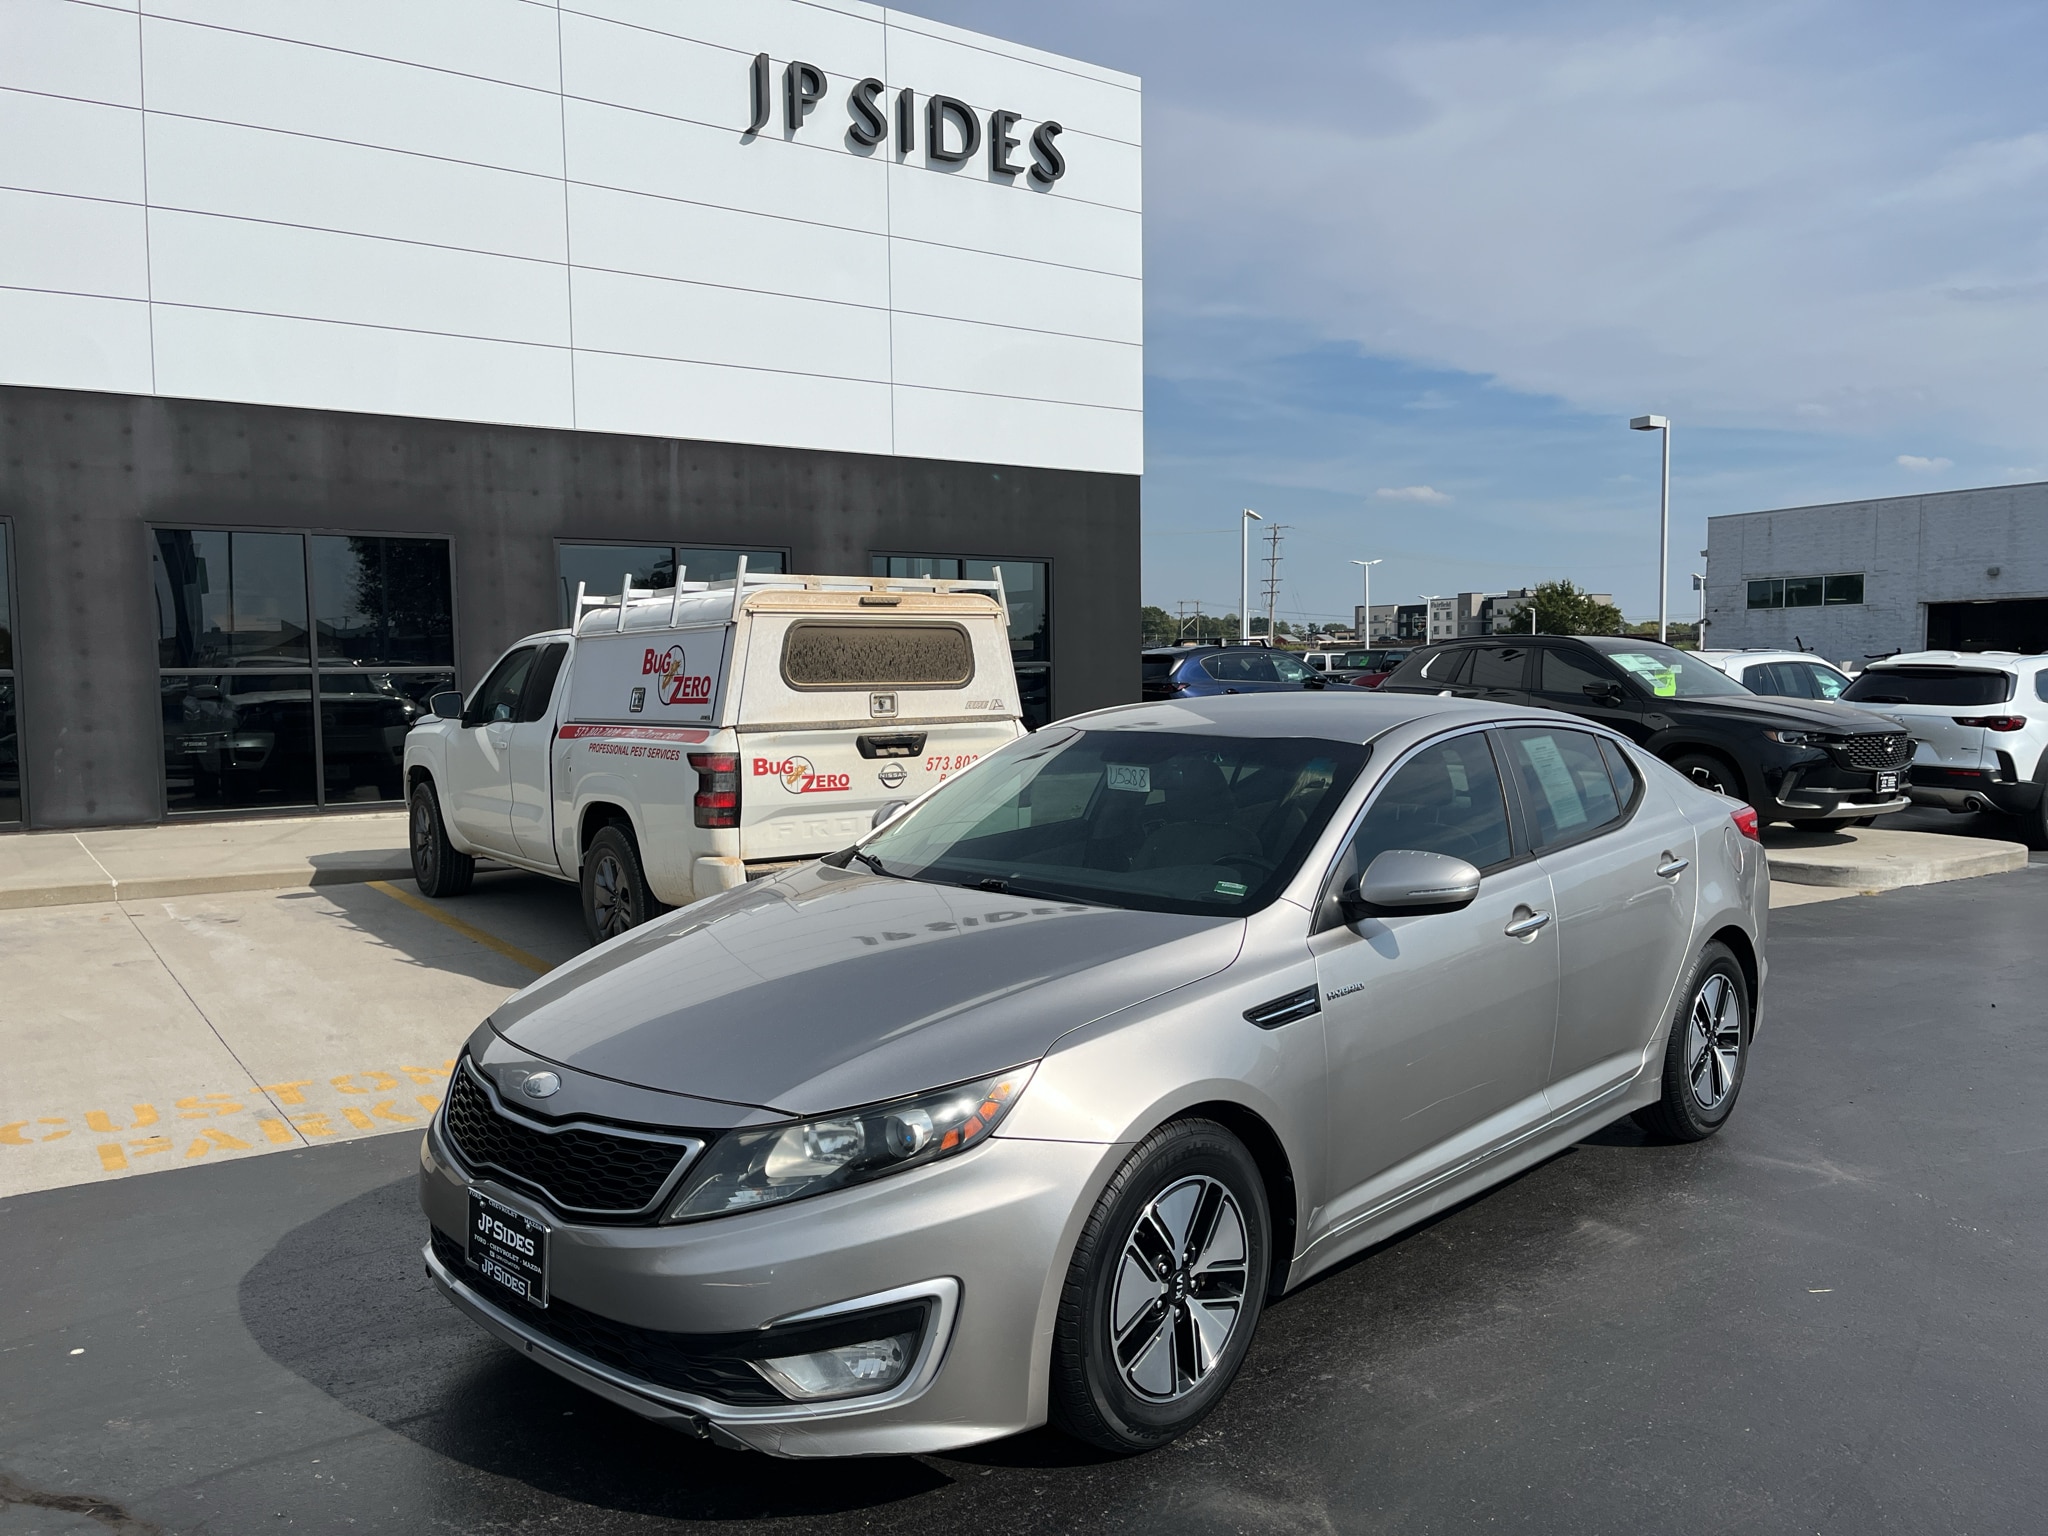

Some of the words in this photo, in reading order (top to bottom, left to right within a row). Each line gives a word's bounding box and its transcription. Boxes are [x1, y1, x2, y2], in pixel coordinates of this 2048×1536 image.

[745, 52, 828, 134] JP
[848, 77, 1066, 183] SIDES
[669, 676, 711, 704] ZERO
[588, 743, 629, 756] PROFESSIONAL
[630, 746, 647, 757] PEST
[647, 748, 680, 761] SERVICES
[801, 774, 850, 793] ZERO
[477, 1212, 493, 1234] JP
[493, 1220, 534, 1257] SIDES
[489, 1242, 519, 1263] CHEVROLET
[481, 1259, 494, 1276] JP
[493, 1266, 526, 1296] SIDES
[1175, 1274, 1183, 1299] KIA
